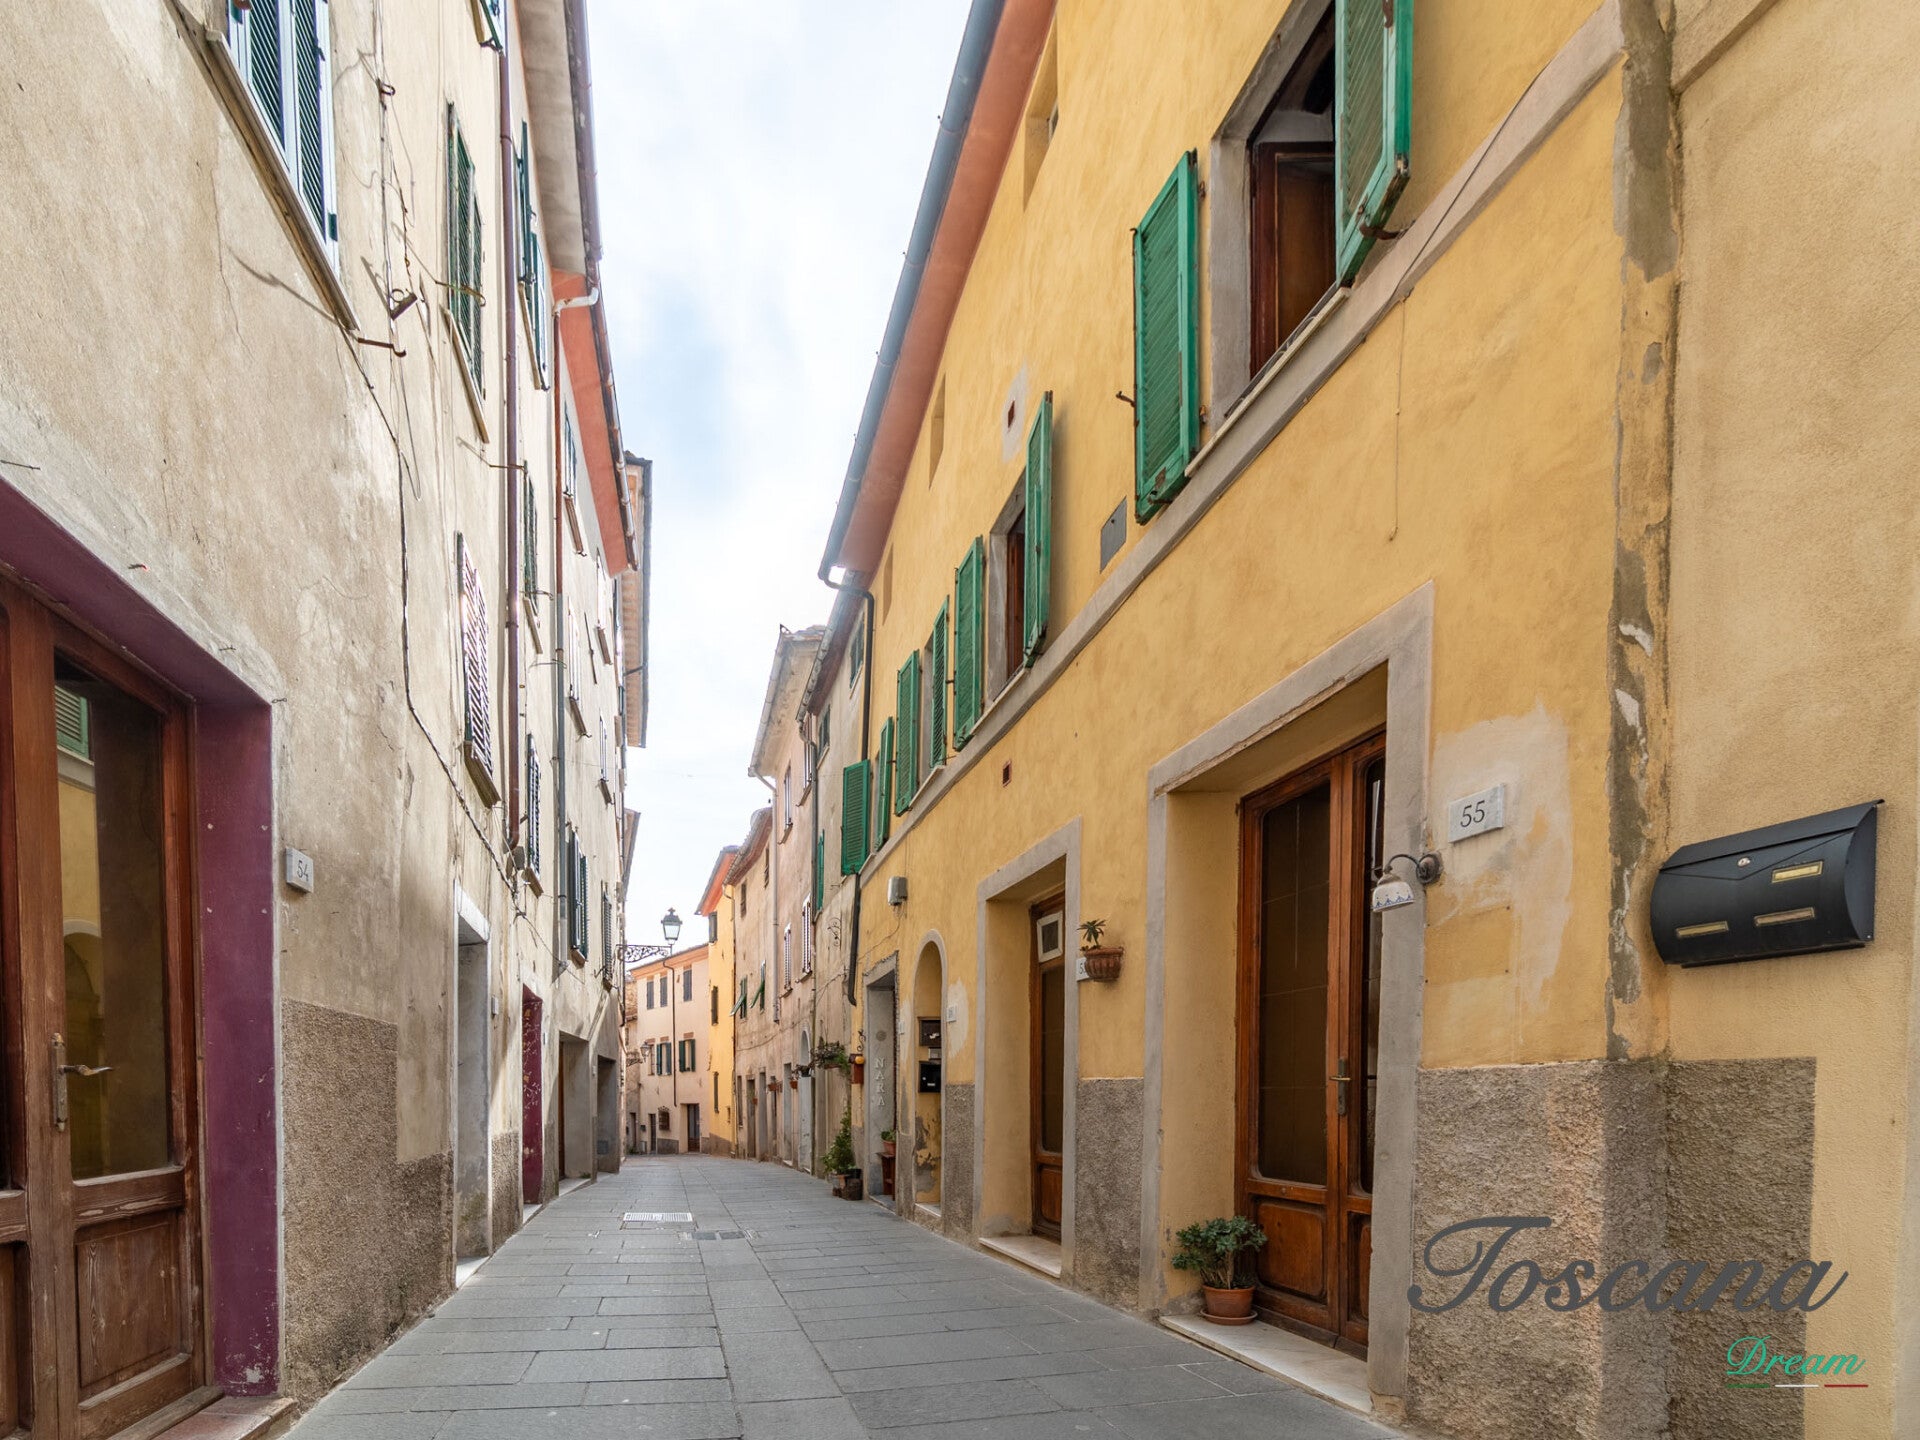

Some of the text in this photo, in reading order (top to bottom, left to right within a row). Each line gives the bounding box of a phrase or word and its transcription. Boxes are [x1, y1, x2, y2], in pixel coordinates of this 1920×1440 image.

[1460, 800, 1485, 828] 55
[297, 859, 309, 882] 54
[874, 1056, 885, 1106] NARA
